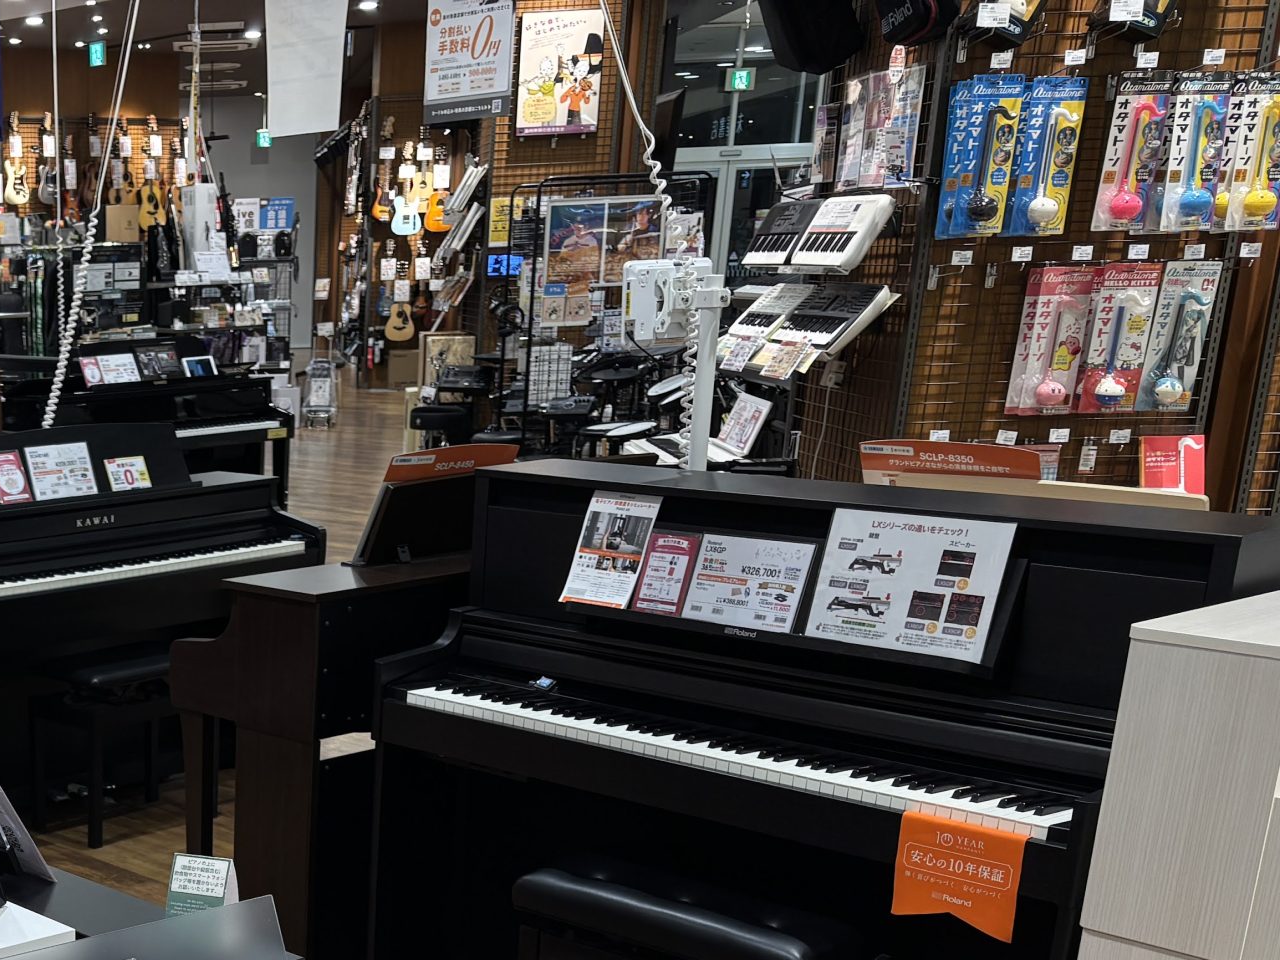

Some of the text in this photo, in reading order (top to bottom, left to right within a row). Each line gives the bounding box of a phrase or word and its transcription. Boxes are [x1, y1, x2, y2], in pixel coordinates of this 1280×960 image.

[889, 3, 912, 26] Roland
[438, 37, 470, 56] 手数料
[439, 24, 472, 39] 分割払い
[964, 102, 985, 170] オタマトーン
[1024, 105, 1044, 172] オタマトーン
[1108, 99, 1131, 167] オタマトーン
[1172, 98, 1192, 167] オタマトーン
[1239, 98, 1260, 167] オタマトーン
[1032, 301, 1053, 361] オタマトーン
[1093, 295, 1115, 358] オタマトーン
[1152, 301, 1172, 355] オタマトーン
[919, 452, 974, 463] SCLP-8350
[76, 515, 115, 528] KAWAI
[733, 628, 756, 638] Roland
[957, 835, 984, 849] YEAR
[911, 850, 1004, 883] 安心の10年保証
[942, 894, 971, 907] Roland
